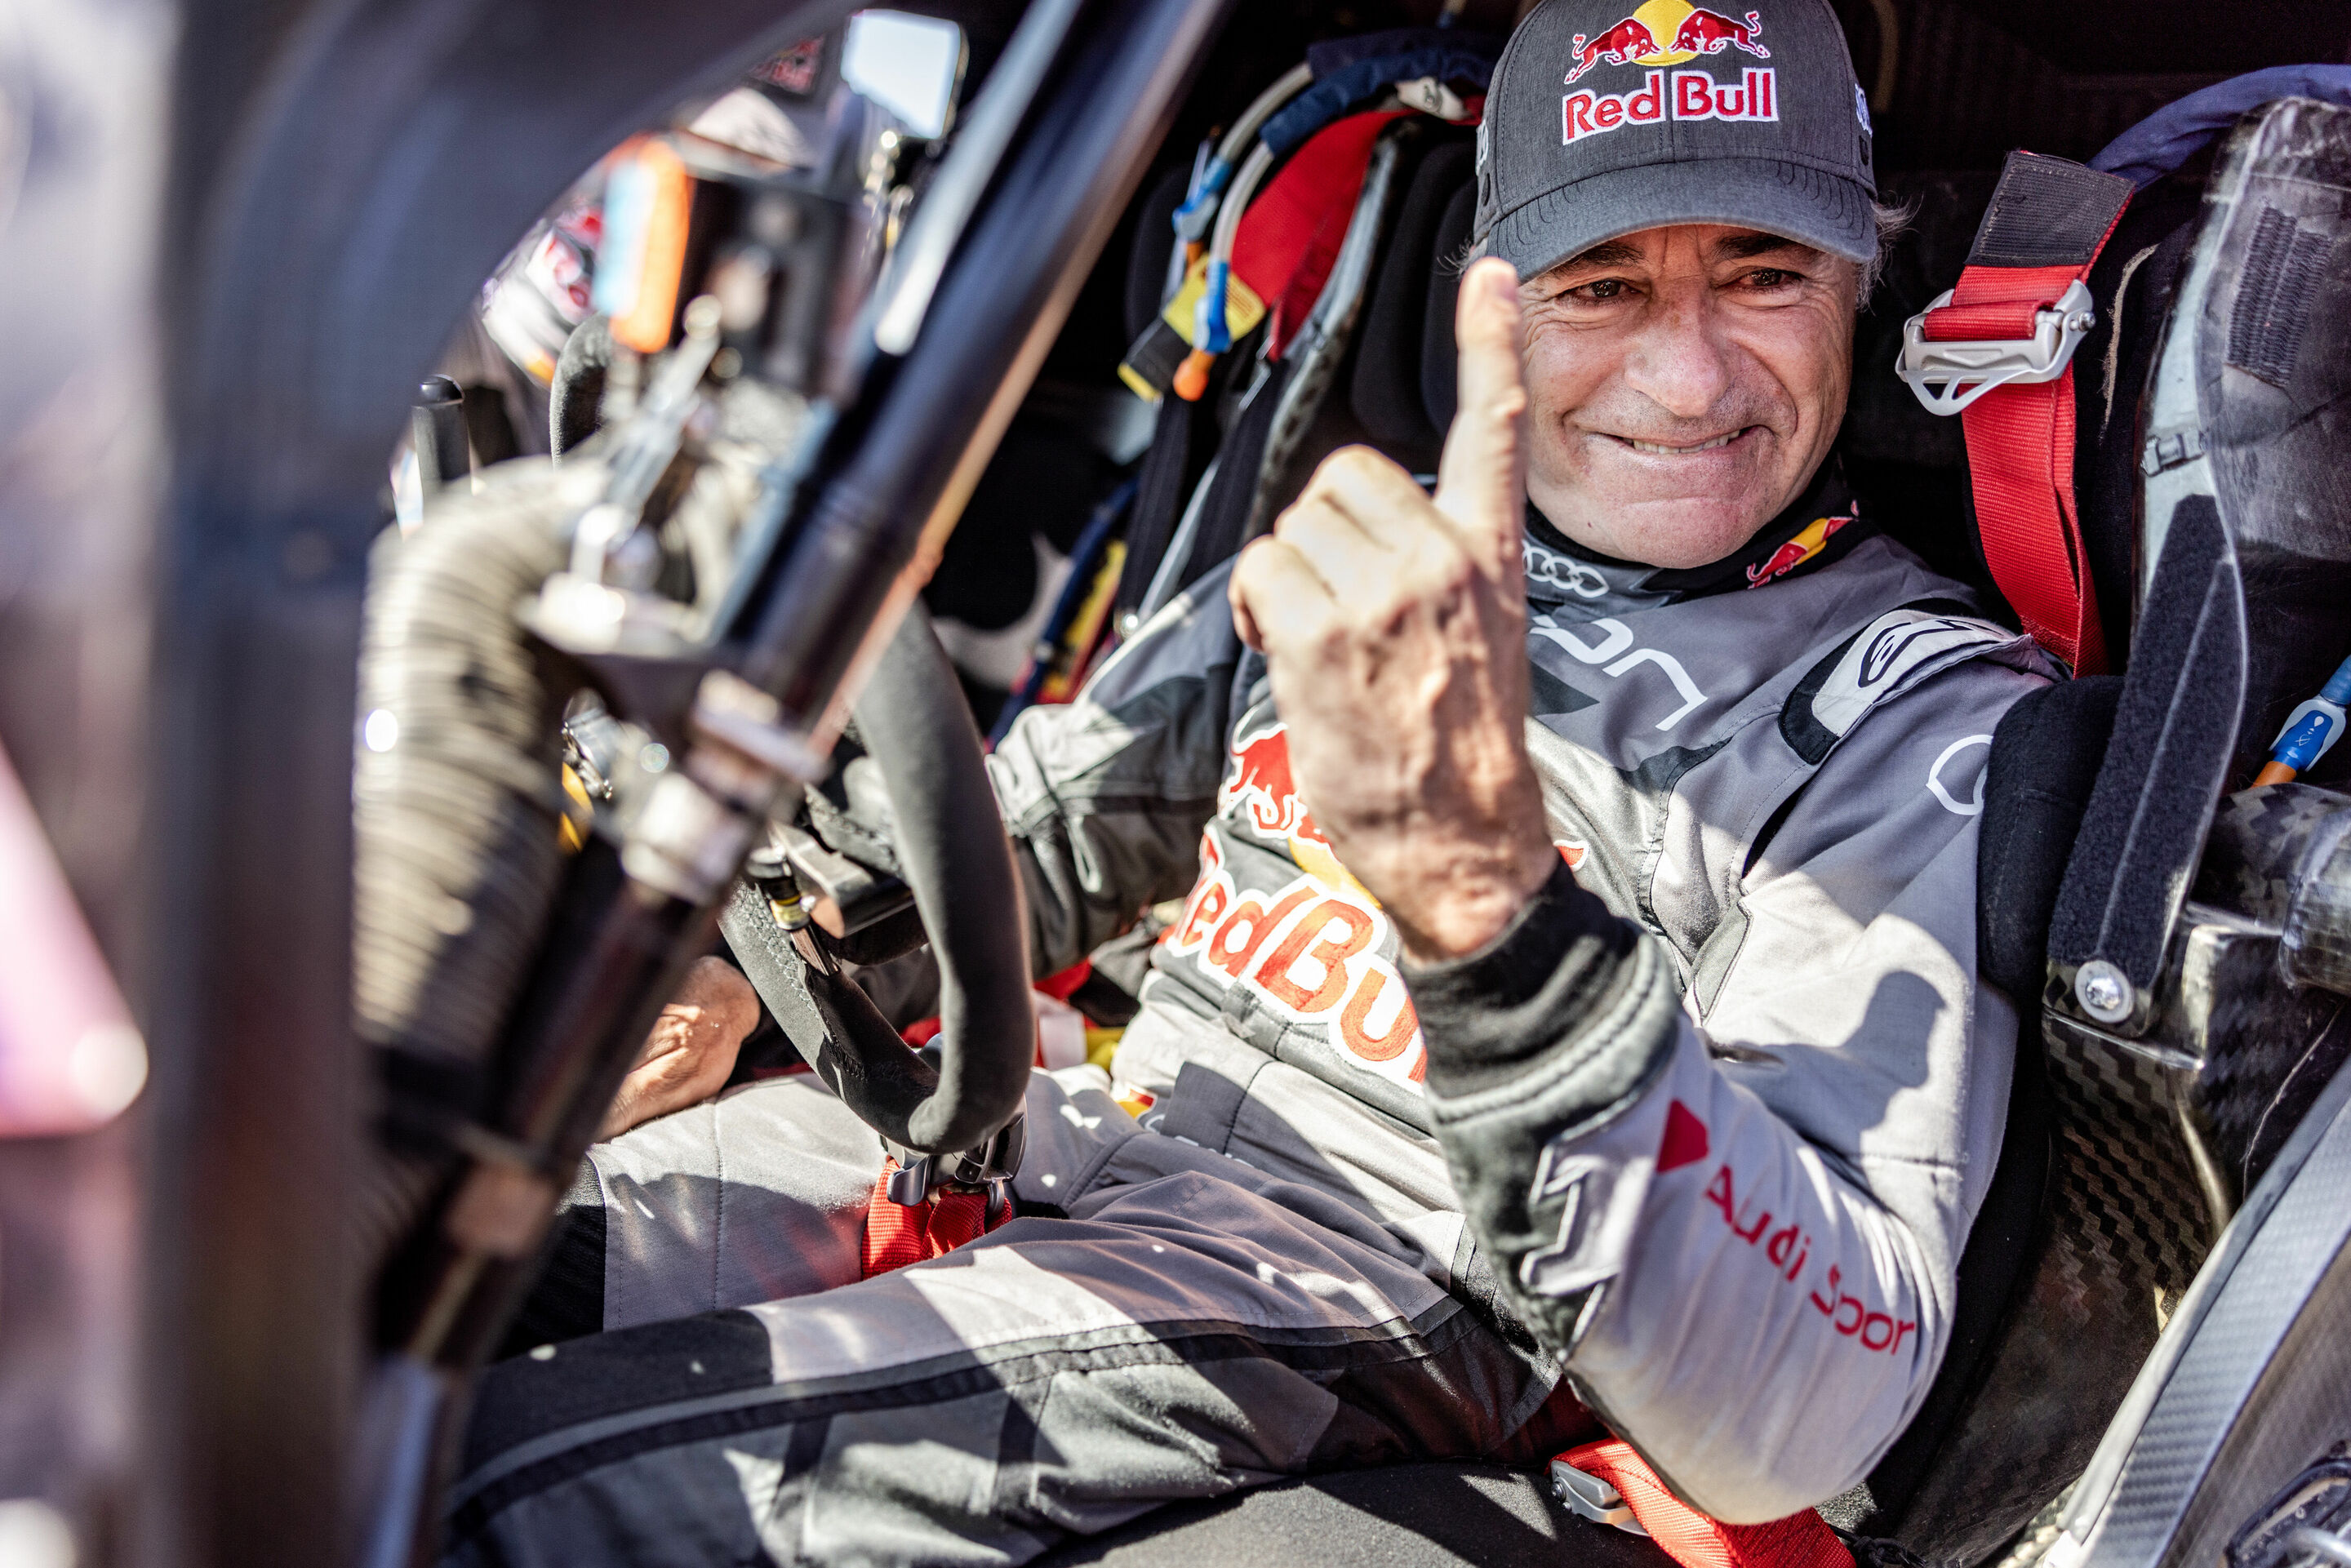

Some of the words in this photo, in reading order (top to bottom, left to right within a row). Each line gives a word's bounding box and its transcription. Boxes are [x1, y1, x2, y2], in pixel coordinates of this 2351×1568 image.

[1567, 73, 1661, 140] Red
[1678, 71, 1771, 118] Bull
[1254, 899, 1427, 1084] Bu
[1703, 1163, 1811, 1283] Audi
